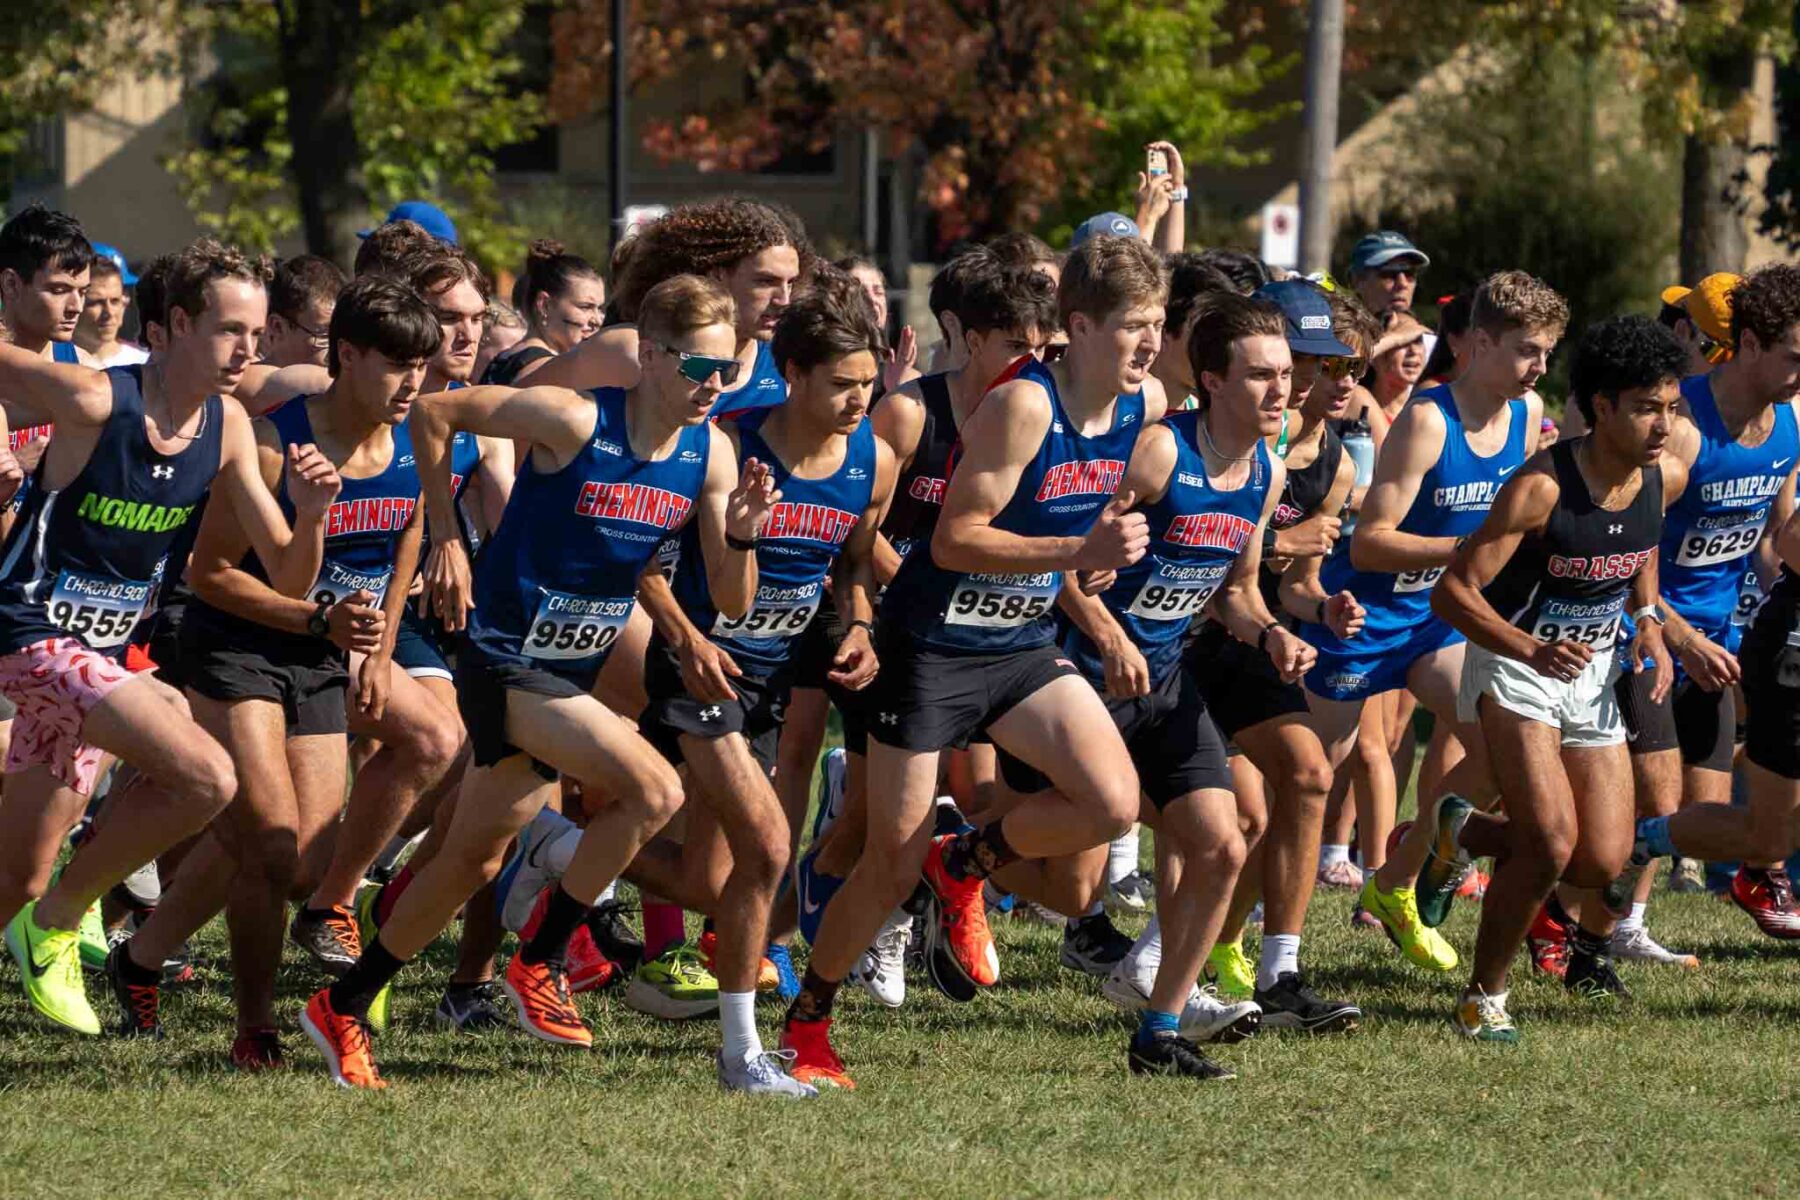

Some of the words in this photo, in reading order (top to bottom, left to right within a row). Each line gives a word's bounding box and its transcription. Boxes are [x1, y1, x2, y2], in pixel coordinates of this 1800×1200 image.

[1177, 472, 1204, 488] RSEQ
[324, 498, 416, 538] EMINOTS
[1686, 528, 1759, 559] 9629
[954, 589, 1049, 620] 9585
[1141, 585, 1214, 612] 9579
[53, 601, 137, 638] 9555
[1538, 618, 1618, 645] 9354
[532, 620, 618, 651] 9580
